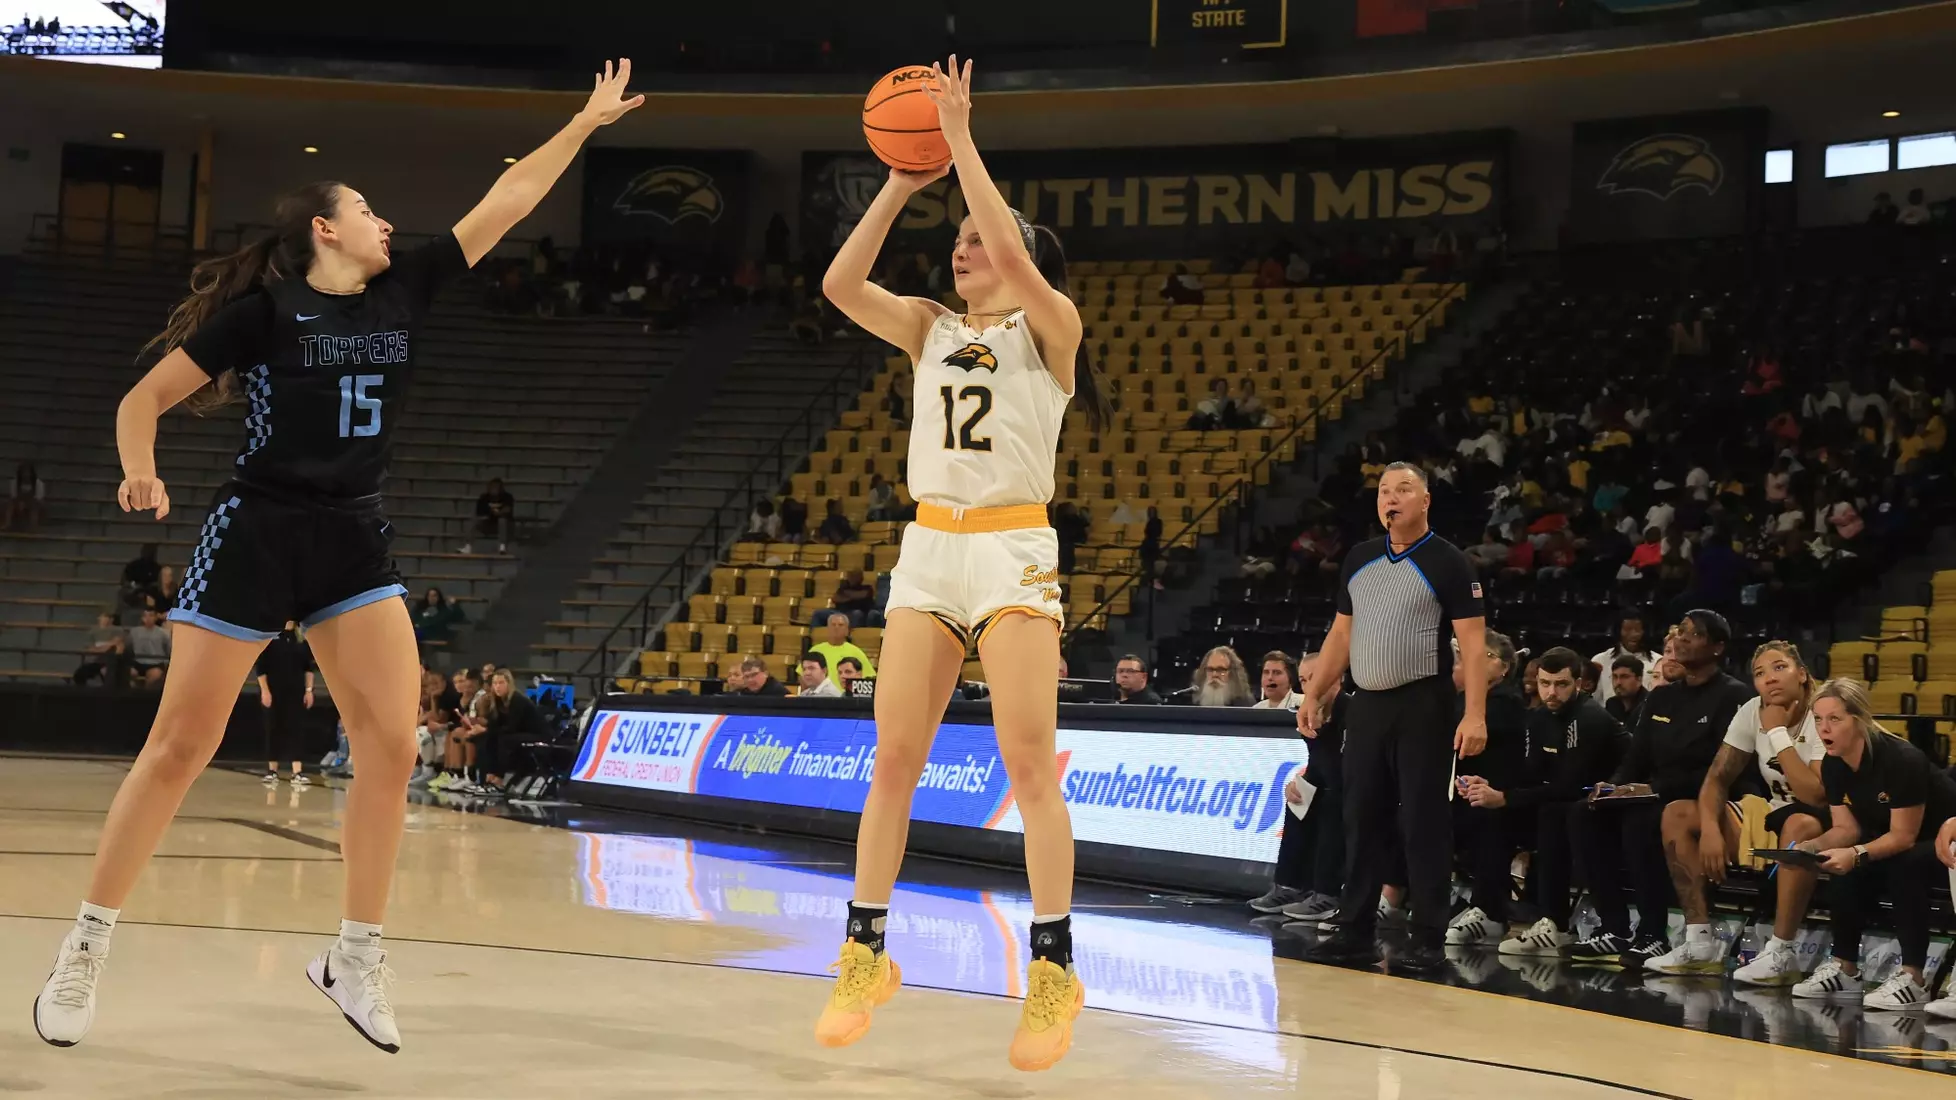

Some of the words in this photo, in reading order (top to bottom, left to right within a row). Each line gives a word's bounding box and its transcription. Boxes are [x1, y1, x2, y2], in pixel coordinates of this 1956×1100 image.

[1192, 10, 1246, 27] STATE
[892, 70, 935, 86] NCA
[1308, 160, 1495, 222] MISS
[299, 330, 409, 367] TOPPERS
[338, 374, 384, 438] 15
[939, 384, 993, 452] 12
[852, 680, 873, 694] POSS
[610, 719, 701, 758] SUNBELT
[713, 739, 732, 769] A
[728, 733, 793, 780] brighter
[788, 740, 867, 782] financial
[916, 754, 997, 793] awaits!
[1063, 763, 1264, 830] sunbeltfcu.org
